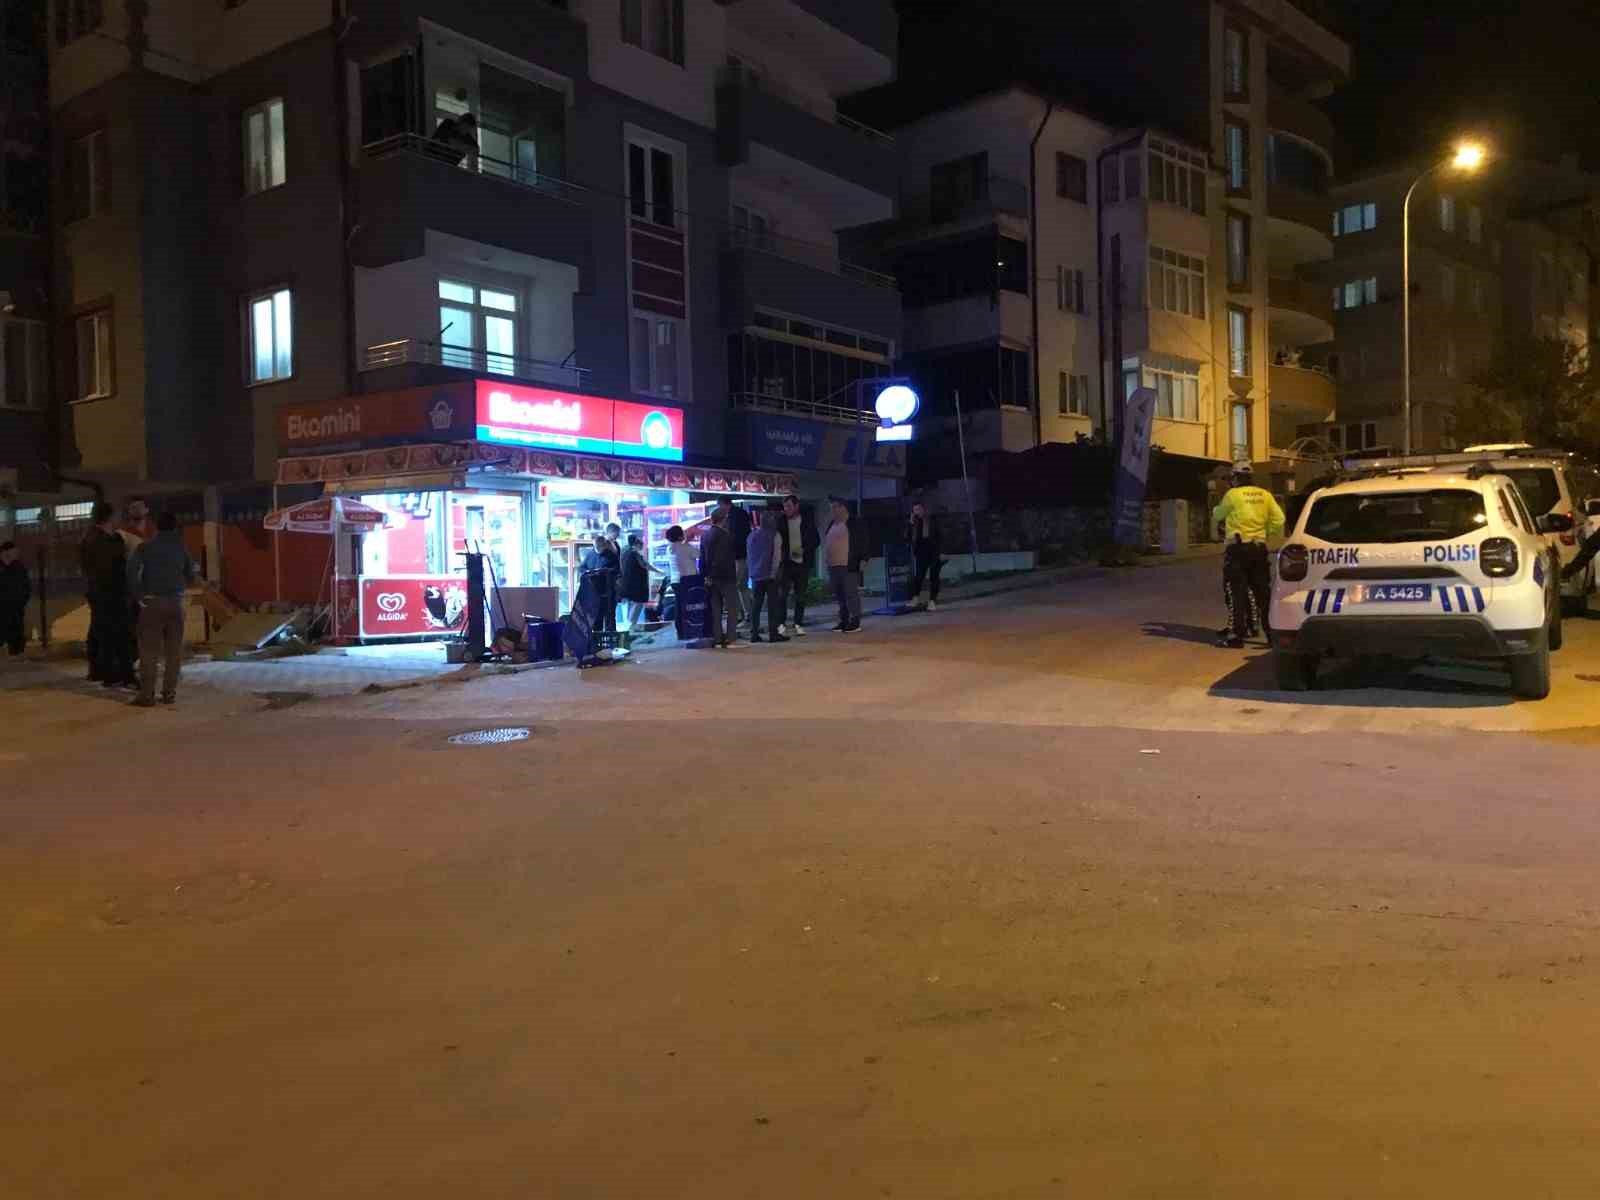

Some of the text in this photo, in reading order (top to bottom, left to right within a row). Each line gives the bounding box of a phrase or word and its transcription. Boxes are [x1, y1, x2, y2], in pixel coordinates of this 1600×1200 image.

[287, 404, 361, 440] Ekomini
[1375, 588, 1387, 600] A
[1389, 587, 1424, 599] 5425
